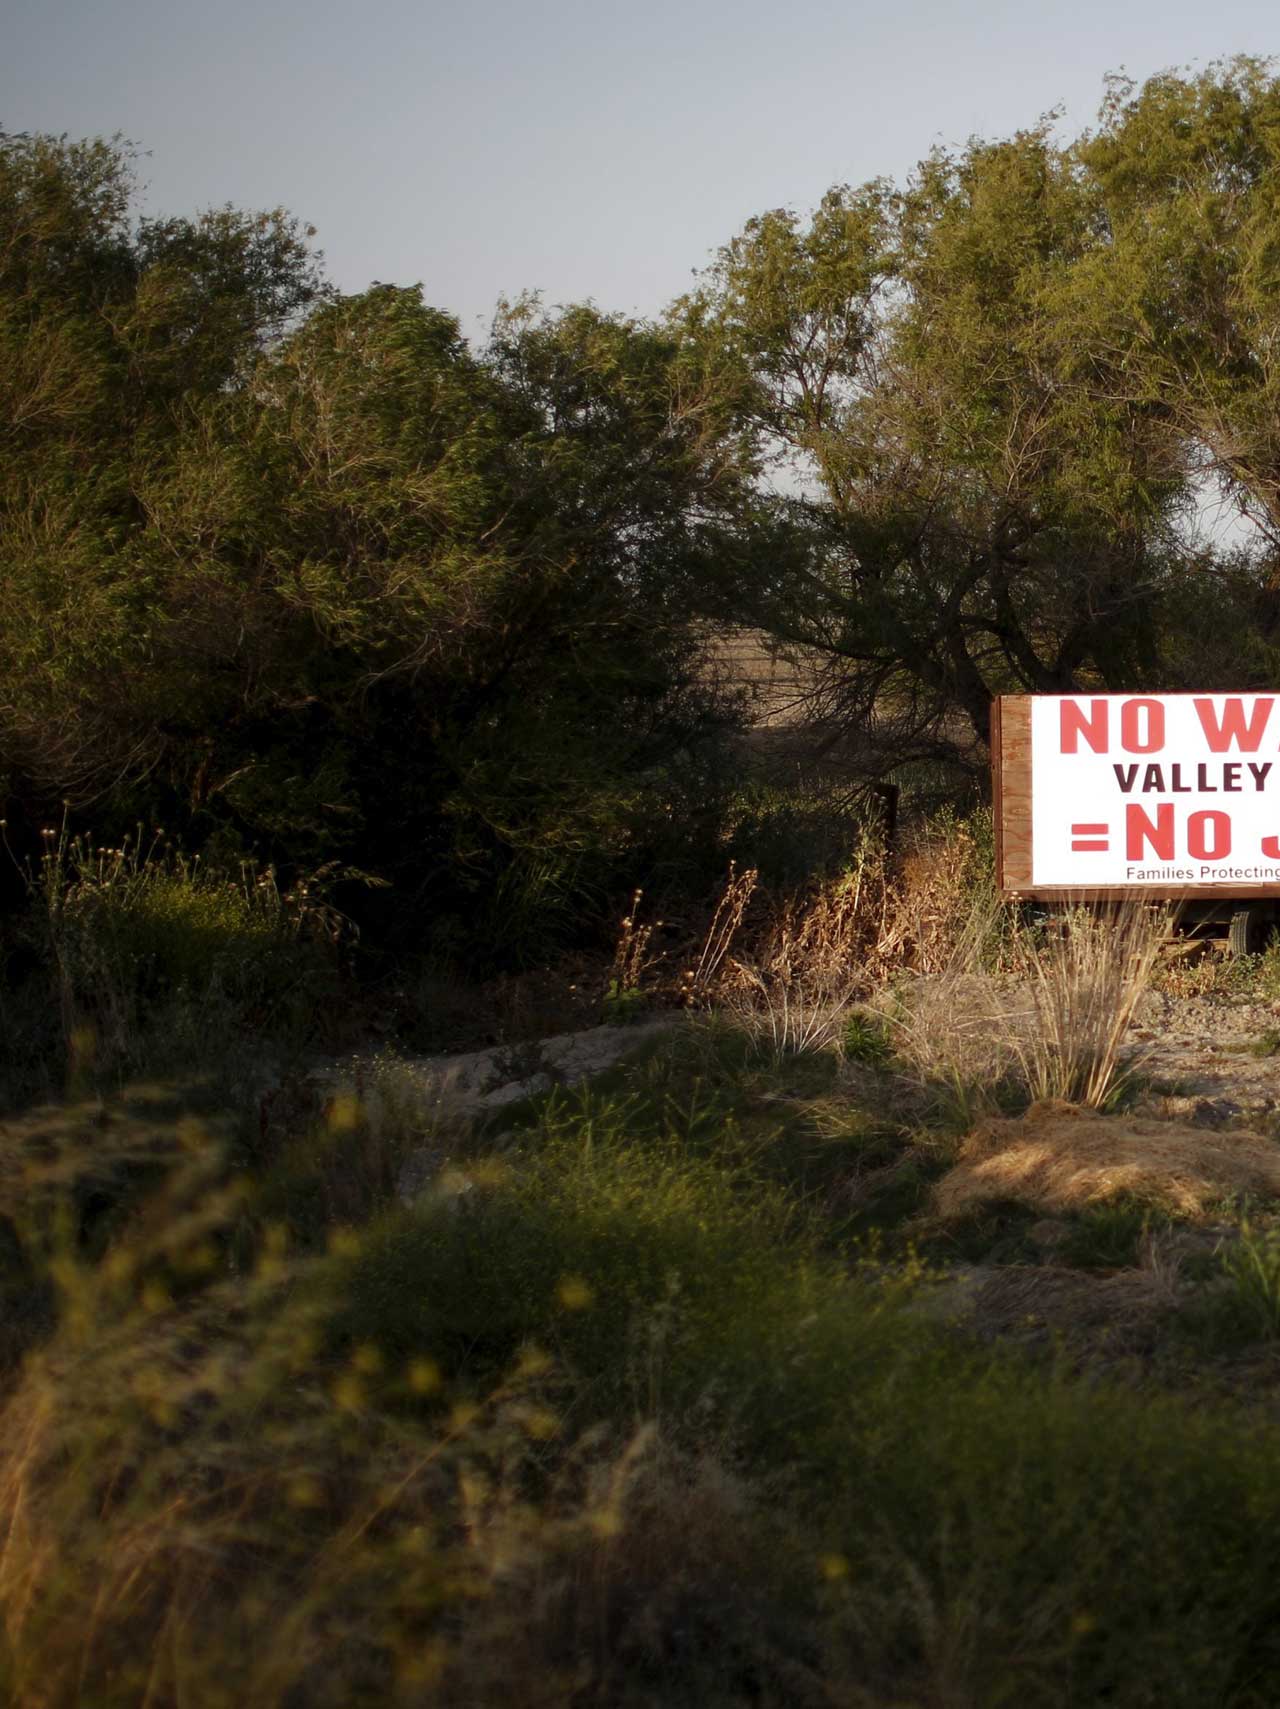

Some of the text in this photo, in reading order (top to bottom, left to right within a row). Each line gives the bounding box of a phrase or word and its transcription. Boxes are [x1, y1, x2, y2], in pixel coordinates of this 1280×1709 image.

[1060, 697, 1165, 754] NO
[1113, 762, 1273, 793] VALLEY
[1127, 867, 1194, 880] Families
